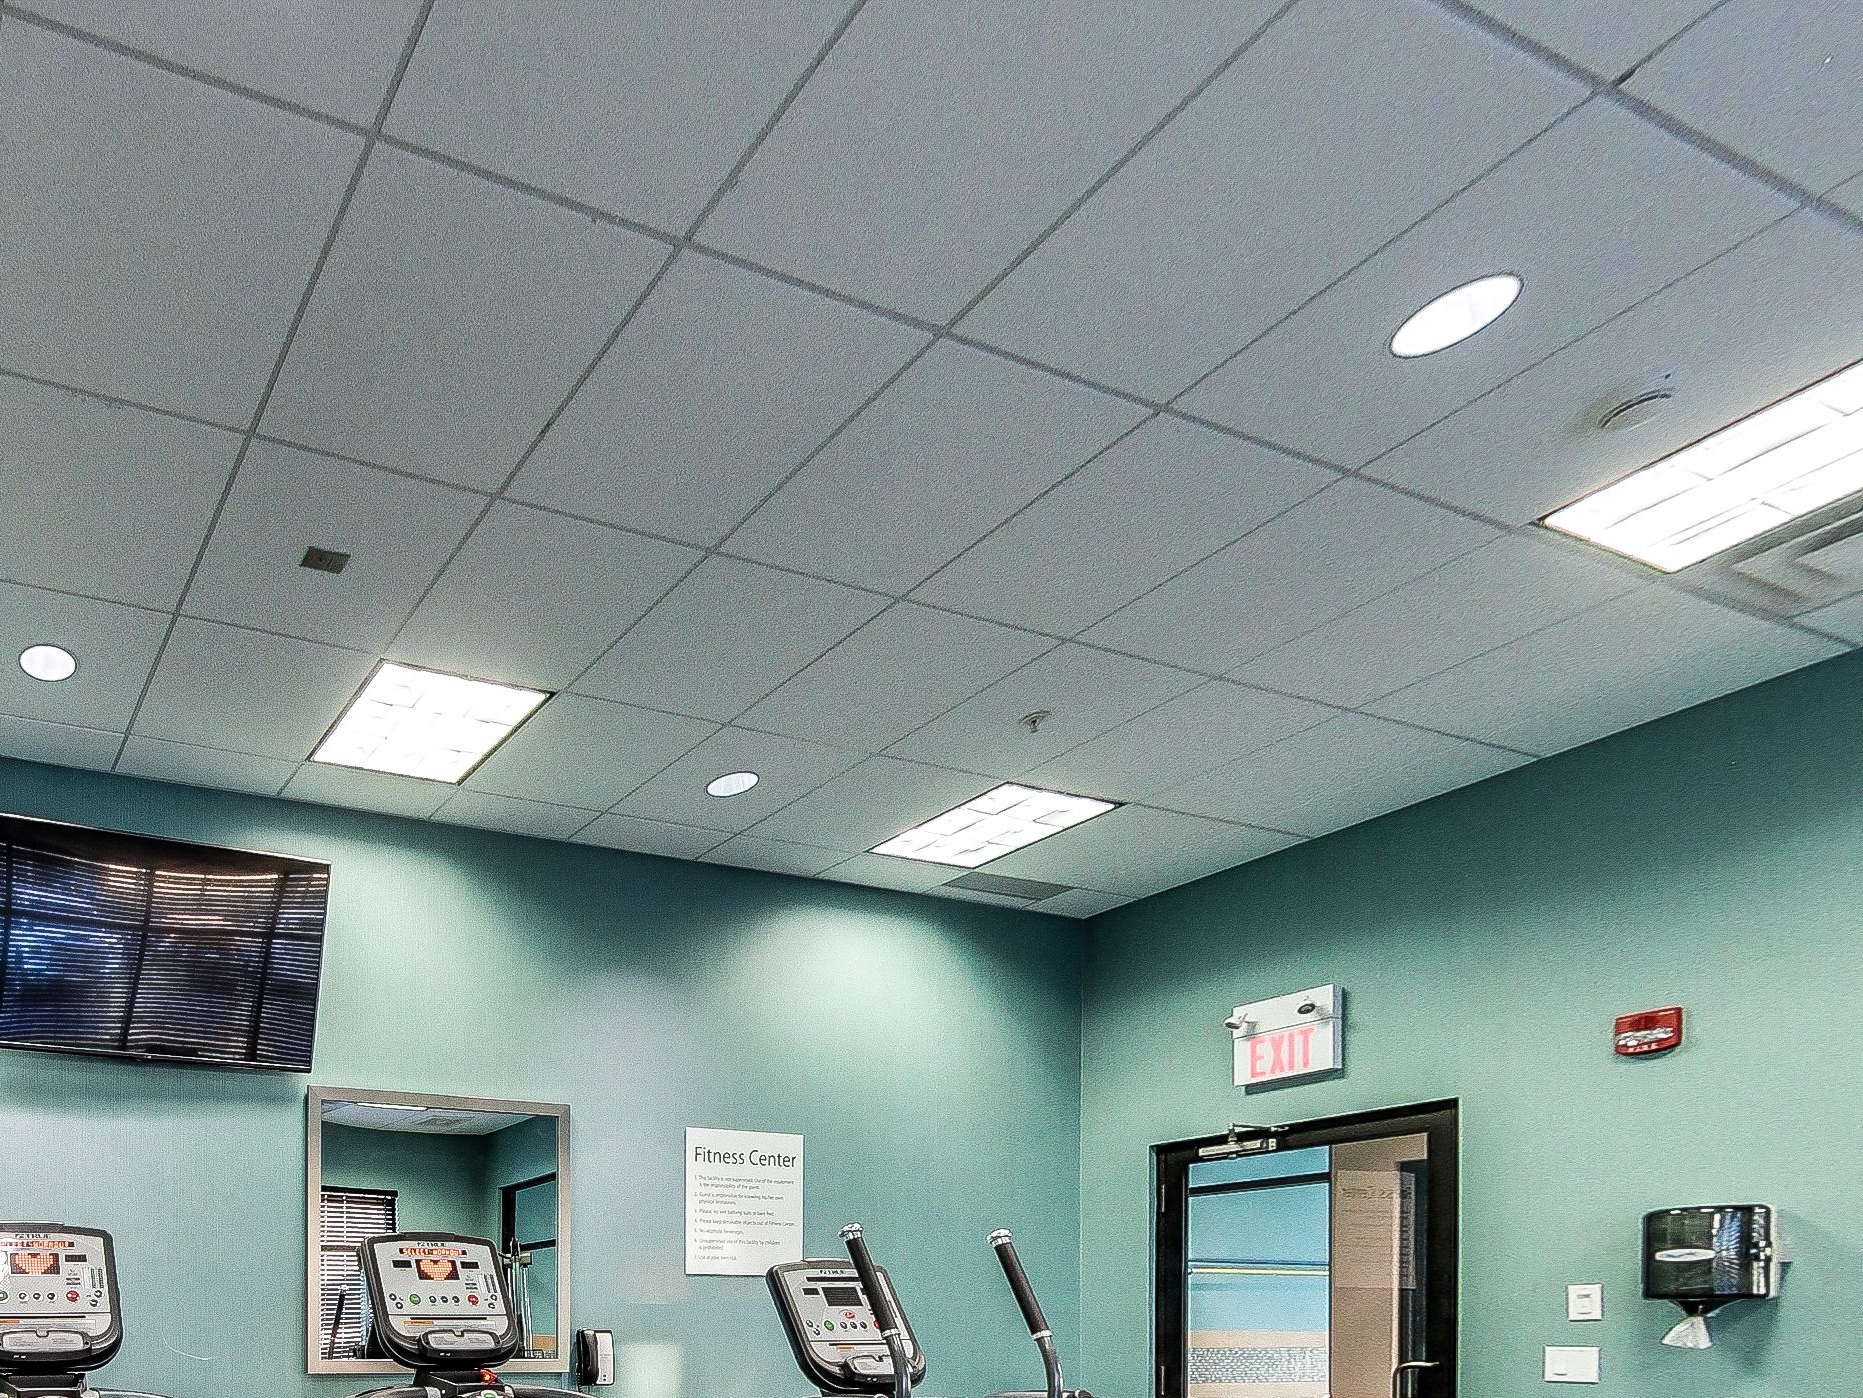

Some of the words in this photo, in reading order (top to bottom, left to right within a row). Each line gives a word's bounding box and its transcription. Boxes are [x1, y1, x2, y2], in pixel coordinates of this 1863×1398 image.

[1250, 1028, 1315, 1079] EXIT
[694, 1146, 745, 1165] Fitness
[749, 1149, 797, 1168] Center
